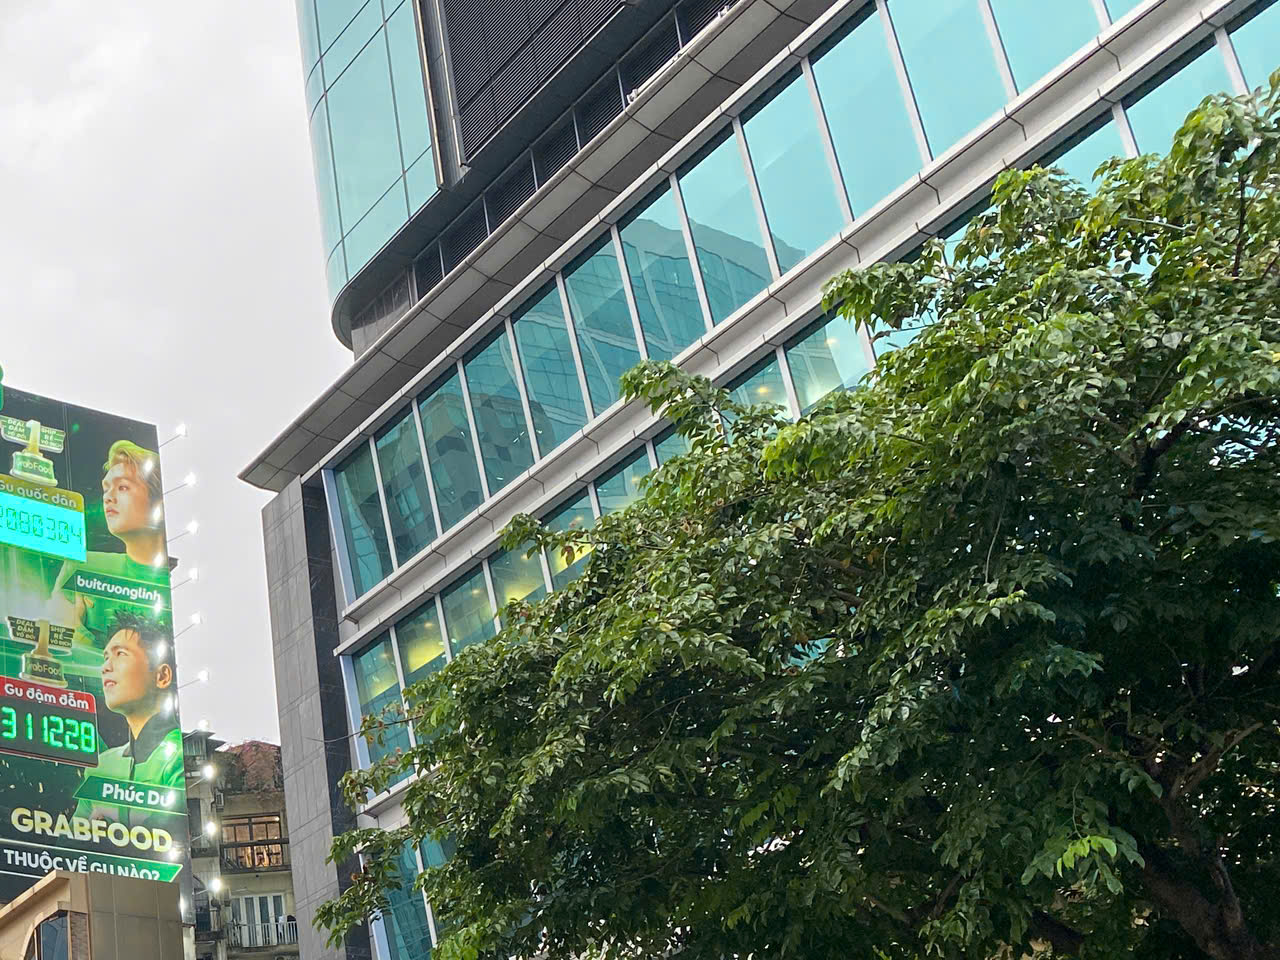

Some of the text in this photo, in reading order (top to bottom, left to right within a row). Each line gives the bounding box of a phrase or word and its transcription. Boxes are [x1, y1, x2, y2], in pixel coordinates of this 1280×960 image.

[18, 487, 49, 503] quốc
[52, 494, 77, 509] dân
[50, 626, 66, 634] SHIP
[4, 683, 23, 697] Gu
[26, 686, 56, 704] đậm
[102, 782, 144, 804] Phúc
[11, 807, 172, 852] GRABFOOD
[3, 849, 63, 873] THUỘC
[65, 855, 88, 873] VỀ
